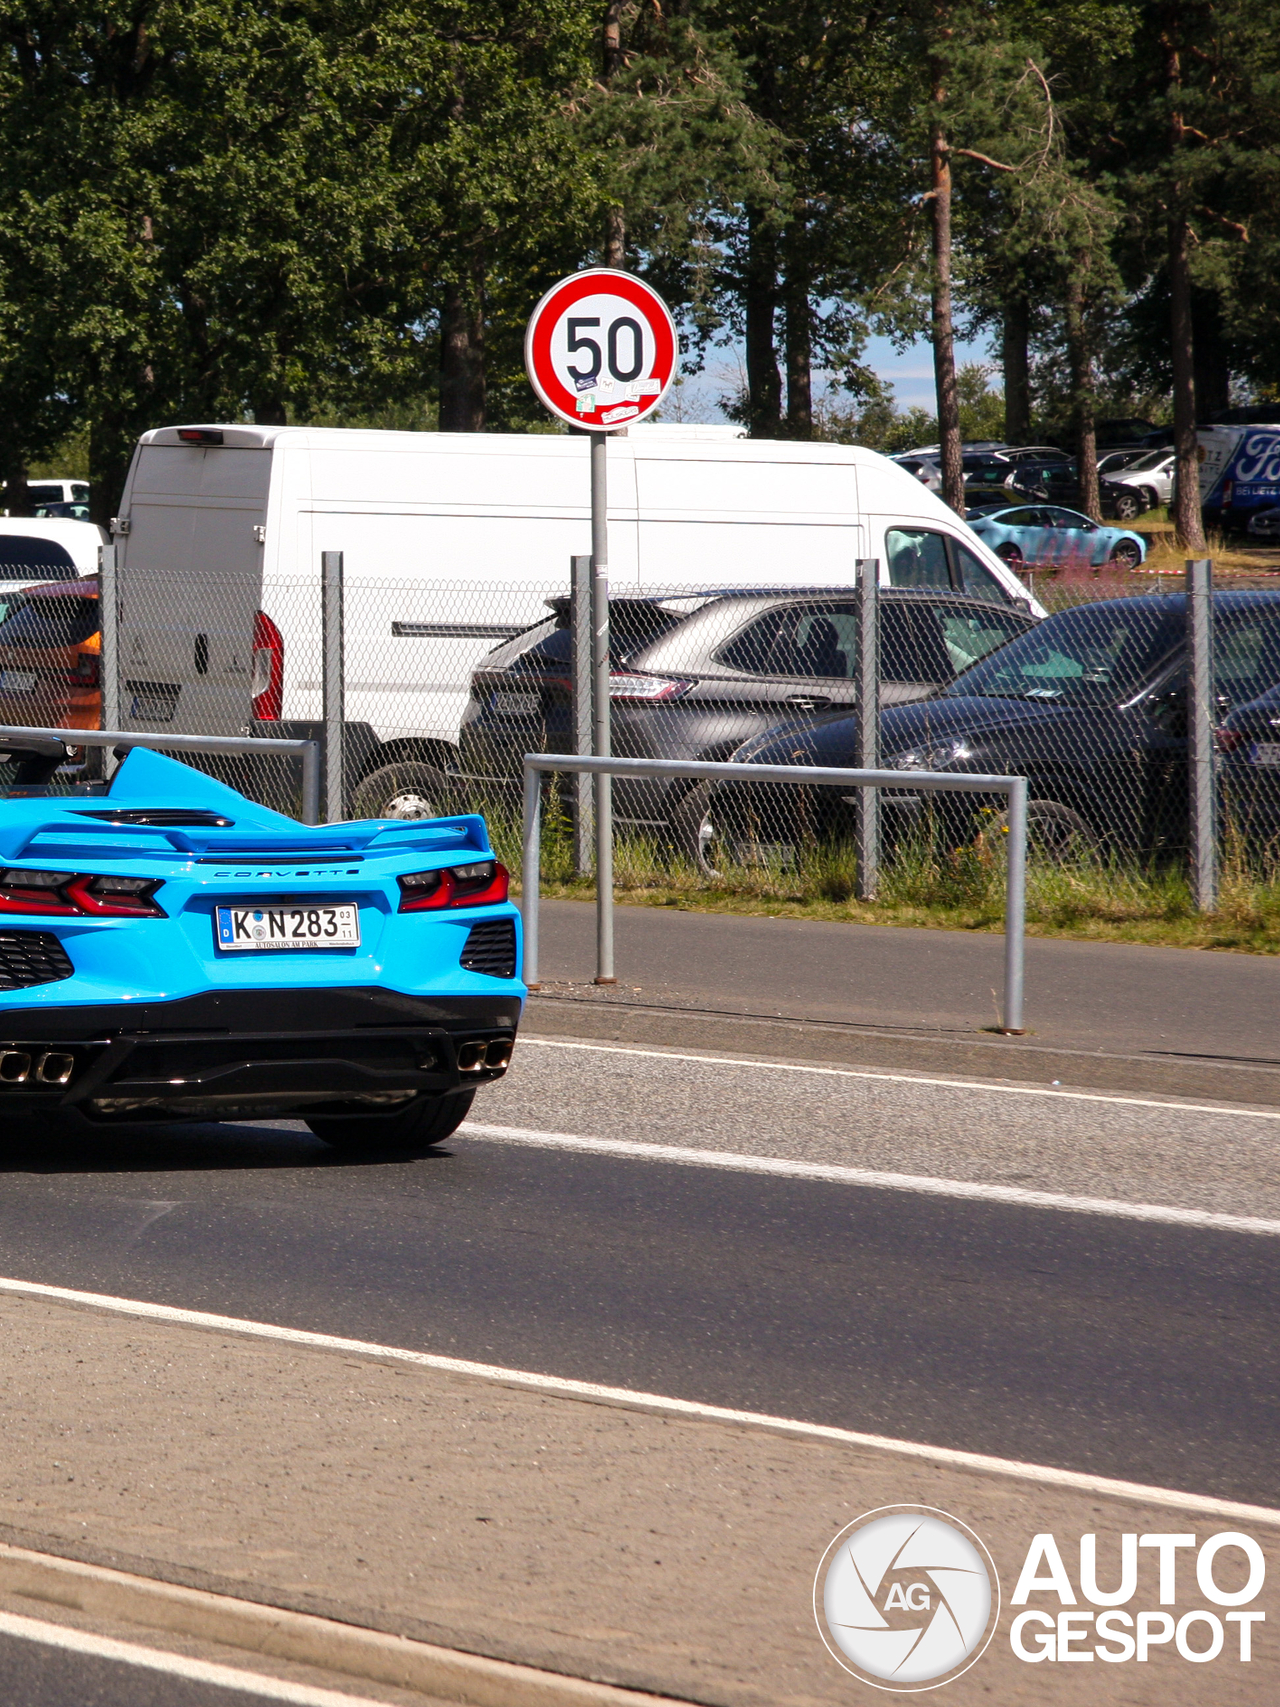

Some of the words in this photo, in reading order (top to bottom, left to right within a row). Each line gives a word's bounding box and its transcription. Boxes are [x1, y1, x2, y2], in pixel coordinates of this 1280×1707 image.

[566, 316, 643, 382] 50
[213, 869, 360, 877] CORVETTE
[339, 911, 351, 919] 03
[233, 911, 252, 939] K
[222, 929, 230, 938] D
[342, 930, 352, 938] 11
[254, 941, 290, 949] AUTOSALON
[302, 940, 318, 948] PARK
